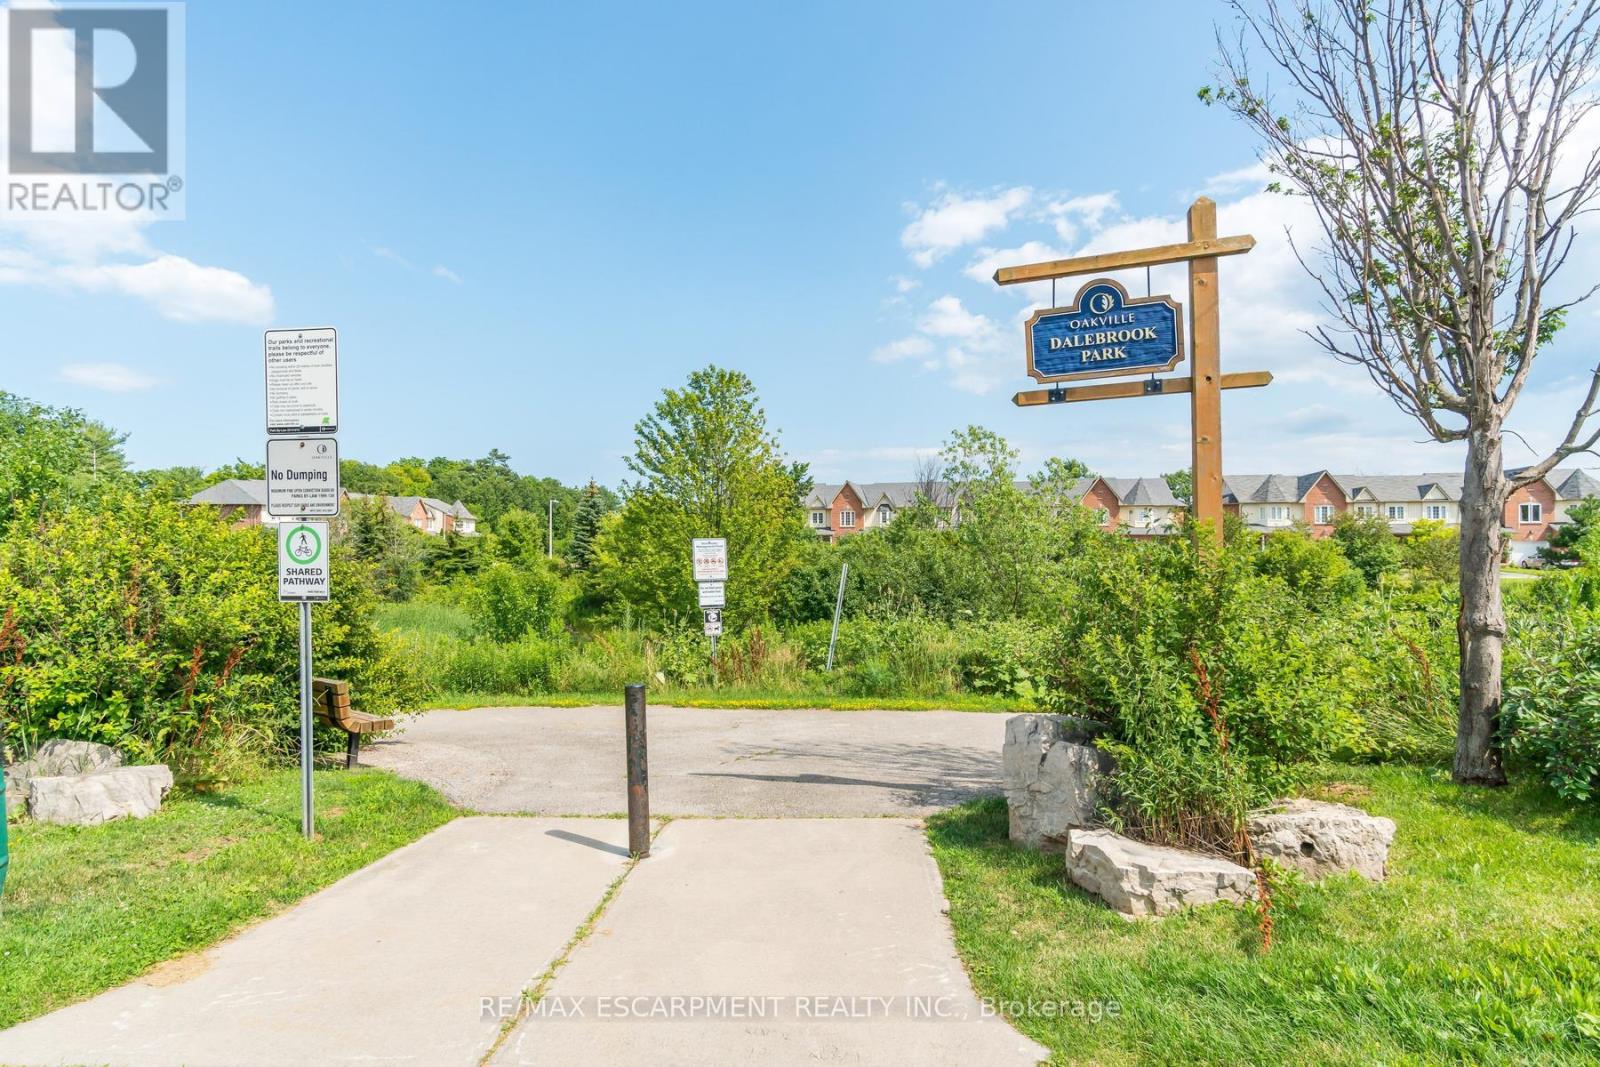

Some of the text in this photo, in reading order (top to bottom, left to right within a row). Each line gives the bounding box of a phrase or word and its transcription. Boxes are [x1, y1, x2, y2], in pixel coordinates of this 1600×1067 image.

[1070, 313, 1136, 329] OAKVILLE
[1050, 326, 1158, 350] DALEBROOK
[1081, 346, 1128, 362] PARK
[271, 469, 328, 482] No Dumping
[286, 568, 322, 576] SHARED
[283, 578, 326, 586] PATHWAY
